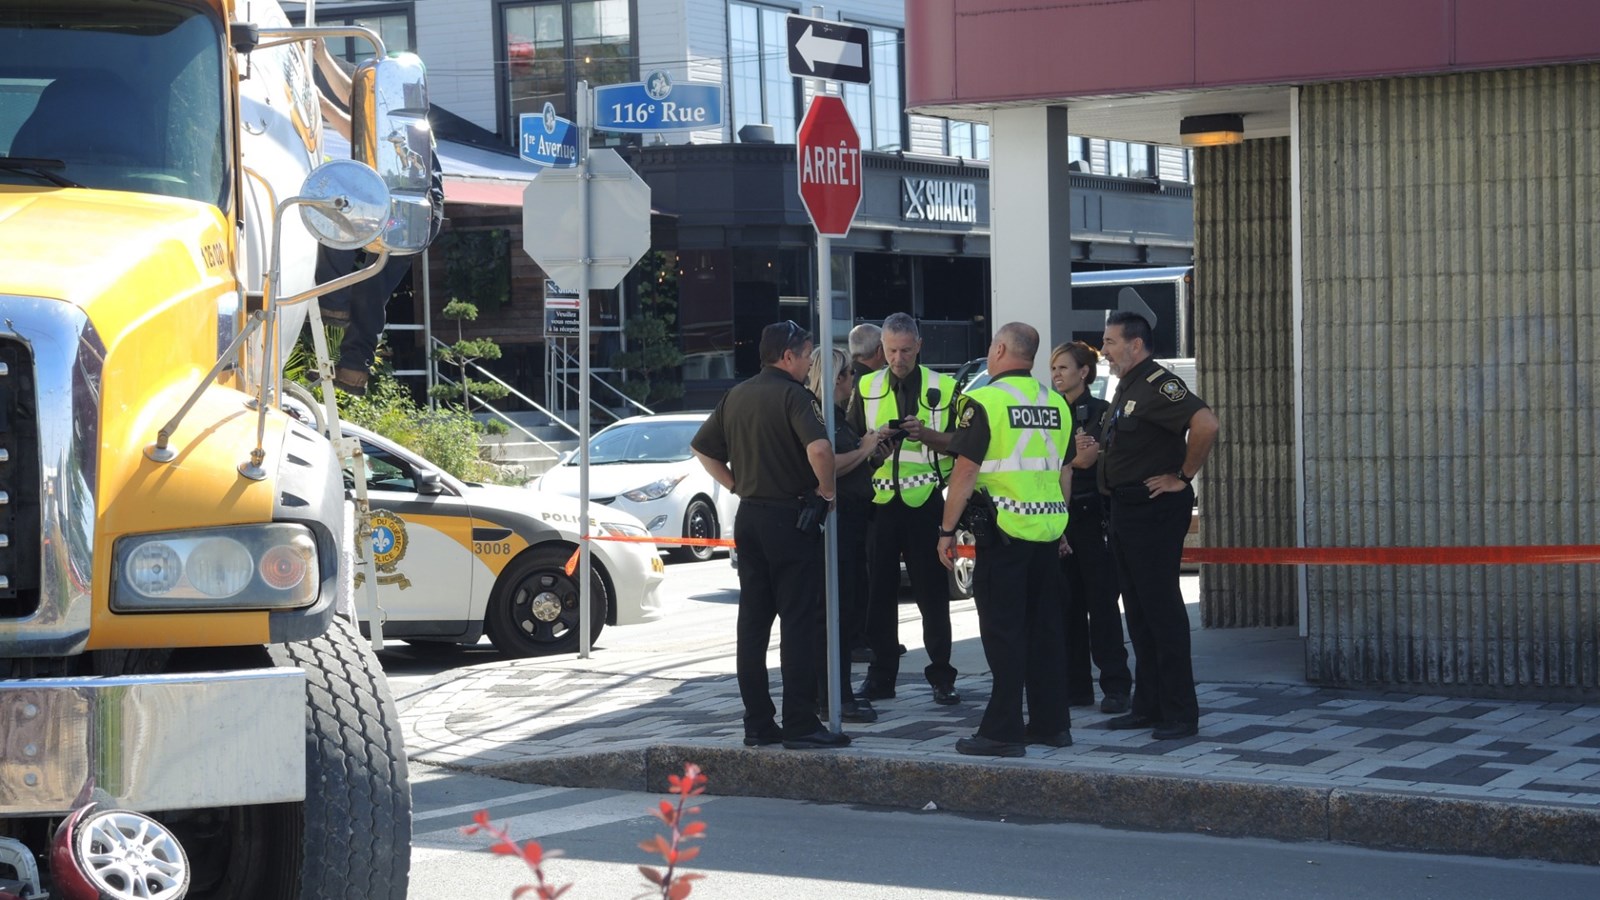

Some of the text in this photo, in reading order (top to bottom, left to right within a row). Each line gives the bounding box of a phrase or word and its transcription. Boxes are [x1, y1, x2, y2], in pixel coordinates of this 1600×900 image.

[661, 102, 706, 122] Rue
[523, 132, 576, 160] 1re Avenue
[802, 139, 858, 186] ARRÊT
[201, 245, 216, 268] 125
[1011, 408, 1058, 426] POLICE
[376, 518, 388, 526] DU
[541, 512, 597, 527] POLIE
[373, 552, 394, 562] OLICE
[474, 542, 511, 555] 3008
